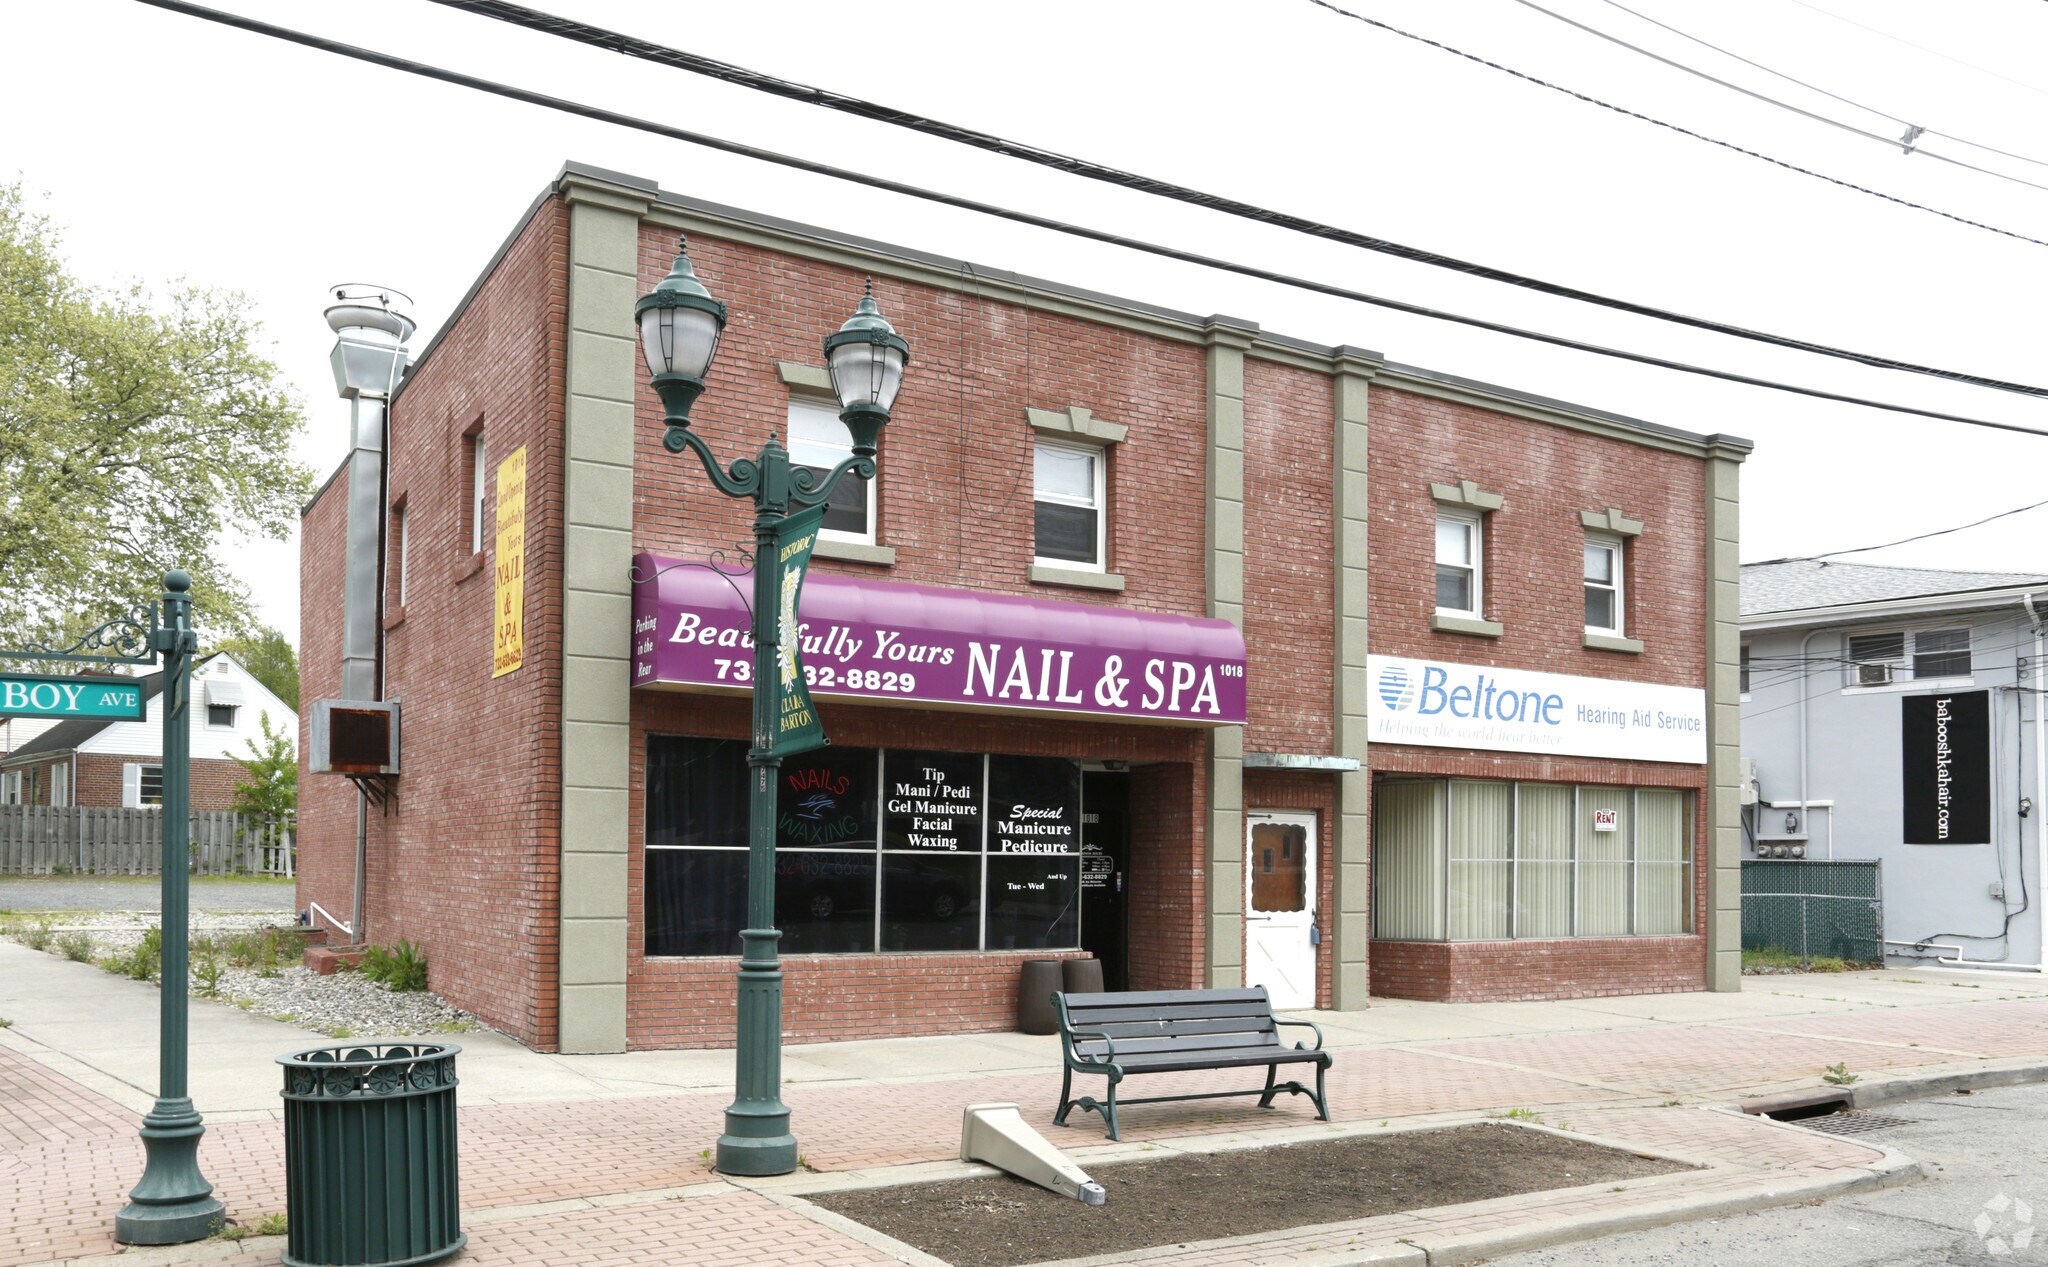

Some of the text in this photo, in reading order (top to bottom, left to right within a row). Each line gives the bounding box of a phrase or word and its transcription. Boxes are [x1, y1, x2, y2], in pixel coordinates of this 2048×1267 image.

[508, 535, 521, 551] Yours
[780, 534, 814, 562] HISTORIC
[497, 556, 520, 589] NAIL
[504, 592, 511, 616] &
[635, 615, 657, 634] Parking
[499, 621, 517, 648] SPA
[669, 612, 955, 665] Beaufully Yours
[638, 637, 653, 655] in the
[638, 662, 652, 677] Rear
[962, 641, 1221, 714] NAIL & SPA
[1220, 664, 1243, 677] 1018
[99, 693, 137, 707] AVE
[781, 695, 805, 714] CLARA
[1417, 666, 1564, 726] Beltone
[781, 709, 813, 732] BARTON
[1577, 704, 1701, 731] Hearing Aid Service
[1378, 719, 1429, 738] Helping
[1430, 723, 1454, 738] the
[1457, 726, 1494, 741] world
[1528, 730, 1564, 745] better
[922, 767, 945, 784] Tip
[1936, 698, 1952, 839] babooshkahair.com
[789, 769, 849, 795] NAILS
[896, 783, 971, 799] Mani / Pedi
[888, 800, 977, 815] Gel Manicure
[1009, 804, 1063, 821] Special
[913, 817, 952, 831] Facial
[1596, 811, 1615, 824] RENT
[779, 811, 858, 844] WAXING
[997, 820, 1072, 835] Manicure
[907, 833, 958, 851] Waxing
[1000, 839, 1068, 853] Pedicure
[1007, 882, 1021, 890] Tue
[1028, 882, 1044, 890] Wed
